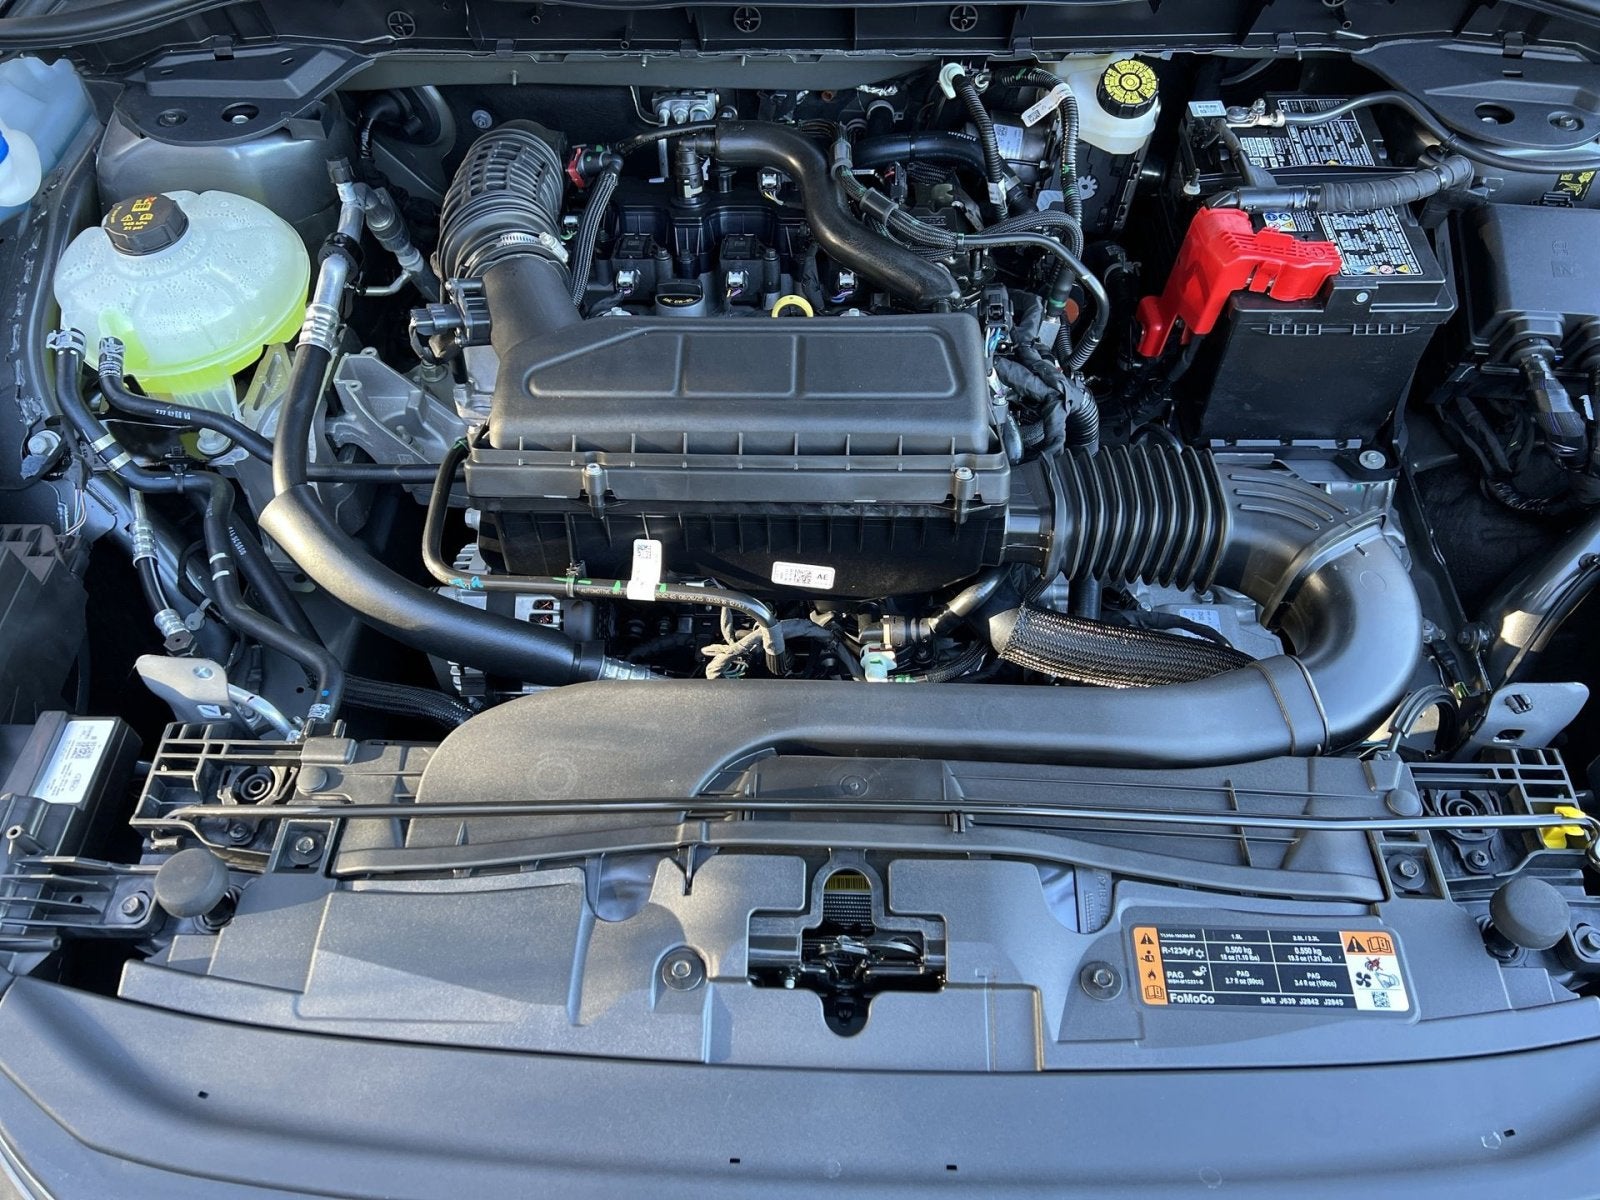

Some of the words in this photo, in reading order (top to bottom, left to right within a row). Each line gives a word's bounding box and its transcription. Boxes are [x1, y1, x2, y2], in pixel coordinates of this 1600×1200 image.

[816, 573, 829, 581] AE
[1161, 946, 1194, 957] R-1234yf
[1224, 945, 1243, 954] 0.500
[1243, 946, 1252, 955] kg
[1294, 946, 1312, 955] 0.550
[1312, 947, 1322, 956] kg
[1166, 971, 1185, 979] PAG
[1169, 993, 1215, 1004] FoMoCo
[1260, 996, 1276, 1004] SAE
